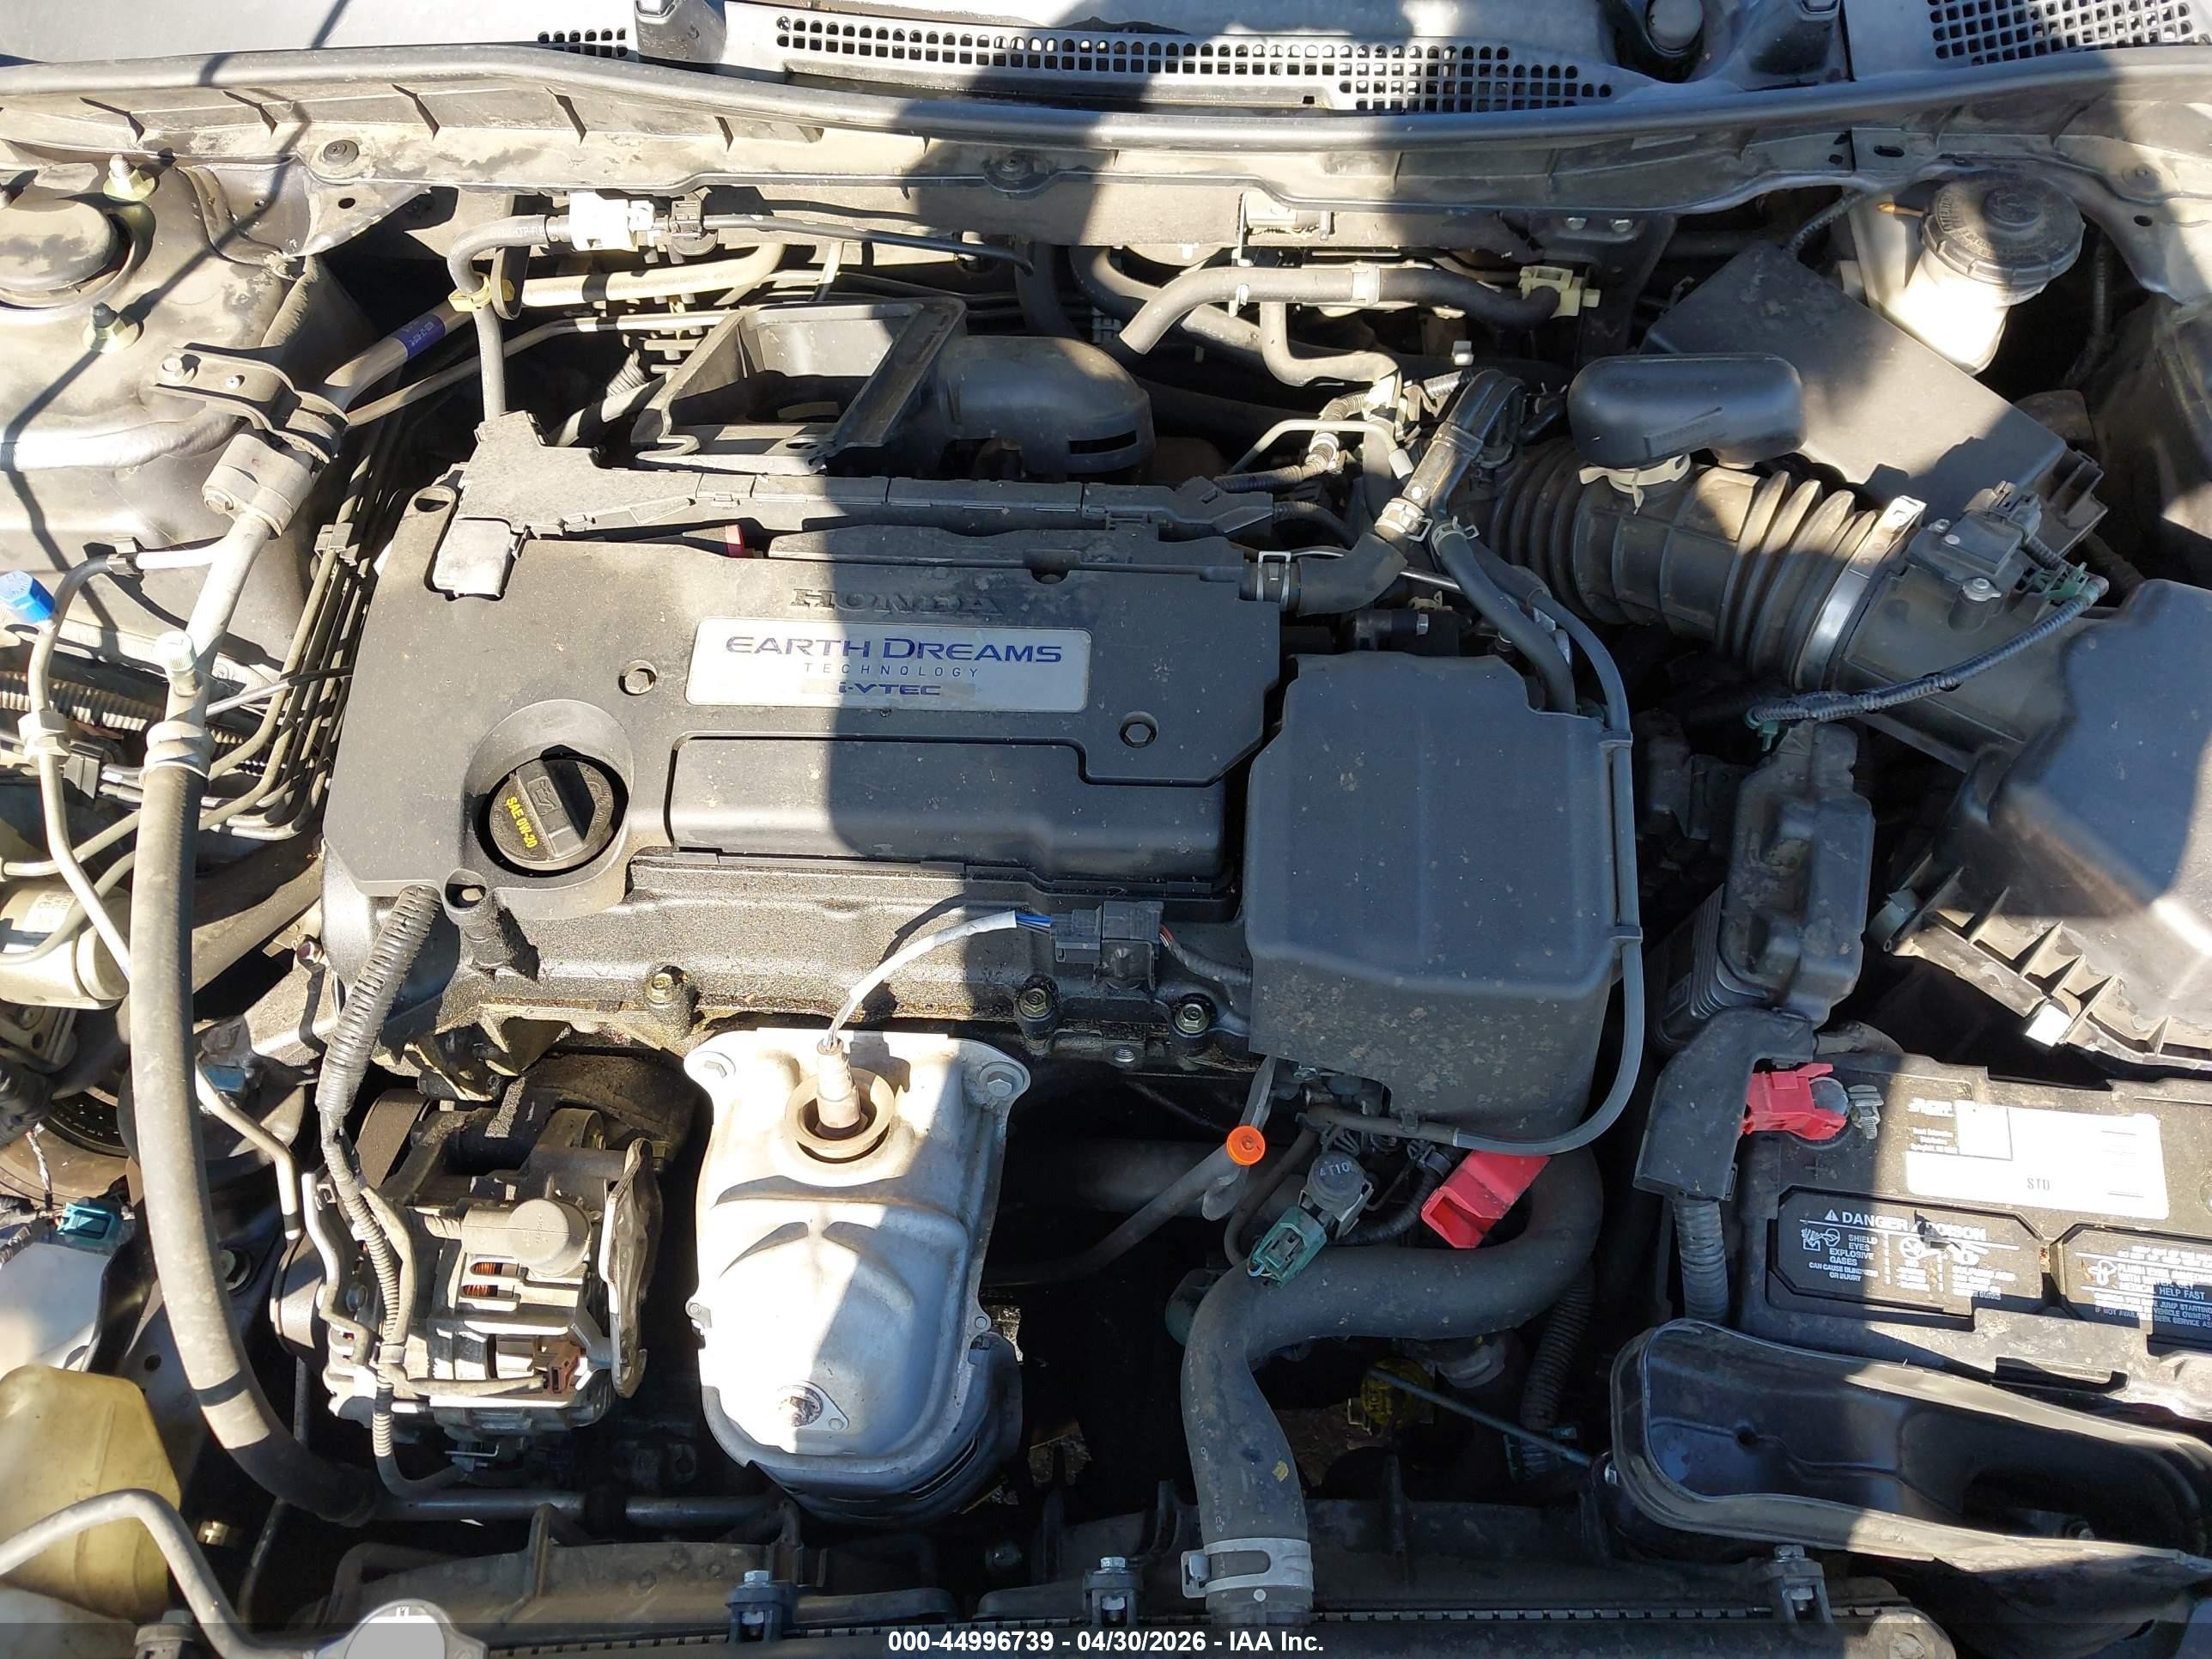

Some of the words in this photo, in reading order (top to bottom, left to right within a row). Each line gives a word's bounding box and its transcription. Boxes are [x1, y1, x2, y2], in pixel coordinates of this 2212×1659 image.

[790, 588, 1004, 616] HONDA
[726, 635, 871, 658] EARTH
[884, 637, 1062, 663] DREAMS
[804, 662, 980, 678] TECHNOLOGY
[838, 681, 942, 696] i-VTEC
[505, 795, 523, 820] SAE
[515, 817, 538, 849] 0W-20
[2027, 1177, 2051, 1190] STD
[1841, 1211, 1909, 1232] DANGER
[1848, 1234, 1878, 1245] SHIELD
[1848, 1242, 1870, 1252] EYES
[1829, 1248, 1875, 1260] EXPLOSIVE
[1808, 1261, 1821, 1270] CAN
[1822, 1263, 1844, 1273] CAUSE
[1829, 1256, 1857, 1267] GASES
[1839, 1273, 1862, 1282] INJURY
[2159, 1286, 2180, 1297] HELP
[2184, 1290, 2205, 1300] FAST
[2160, 1300, 2179, 1309] JUMP
[2180, 1303, 2212, 1314] STARTING
[2153, 1308, 2179, 1317] VEHICLE
[2182, 1311, 2210, 1321] OWNERS
